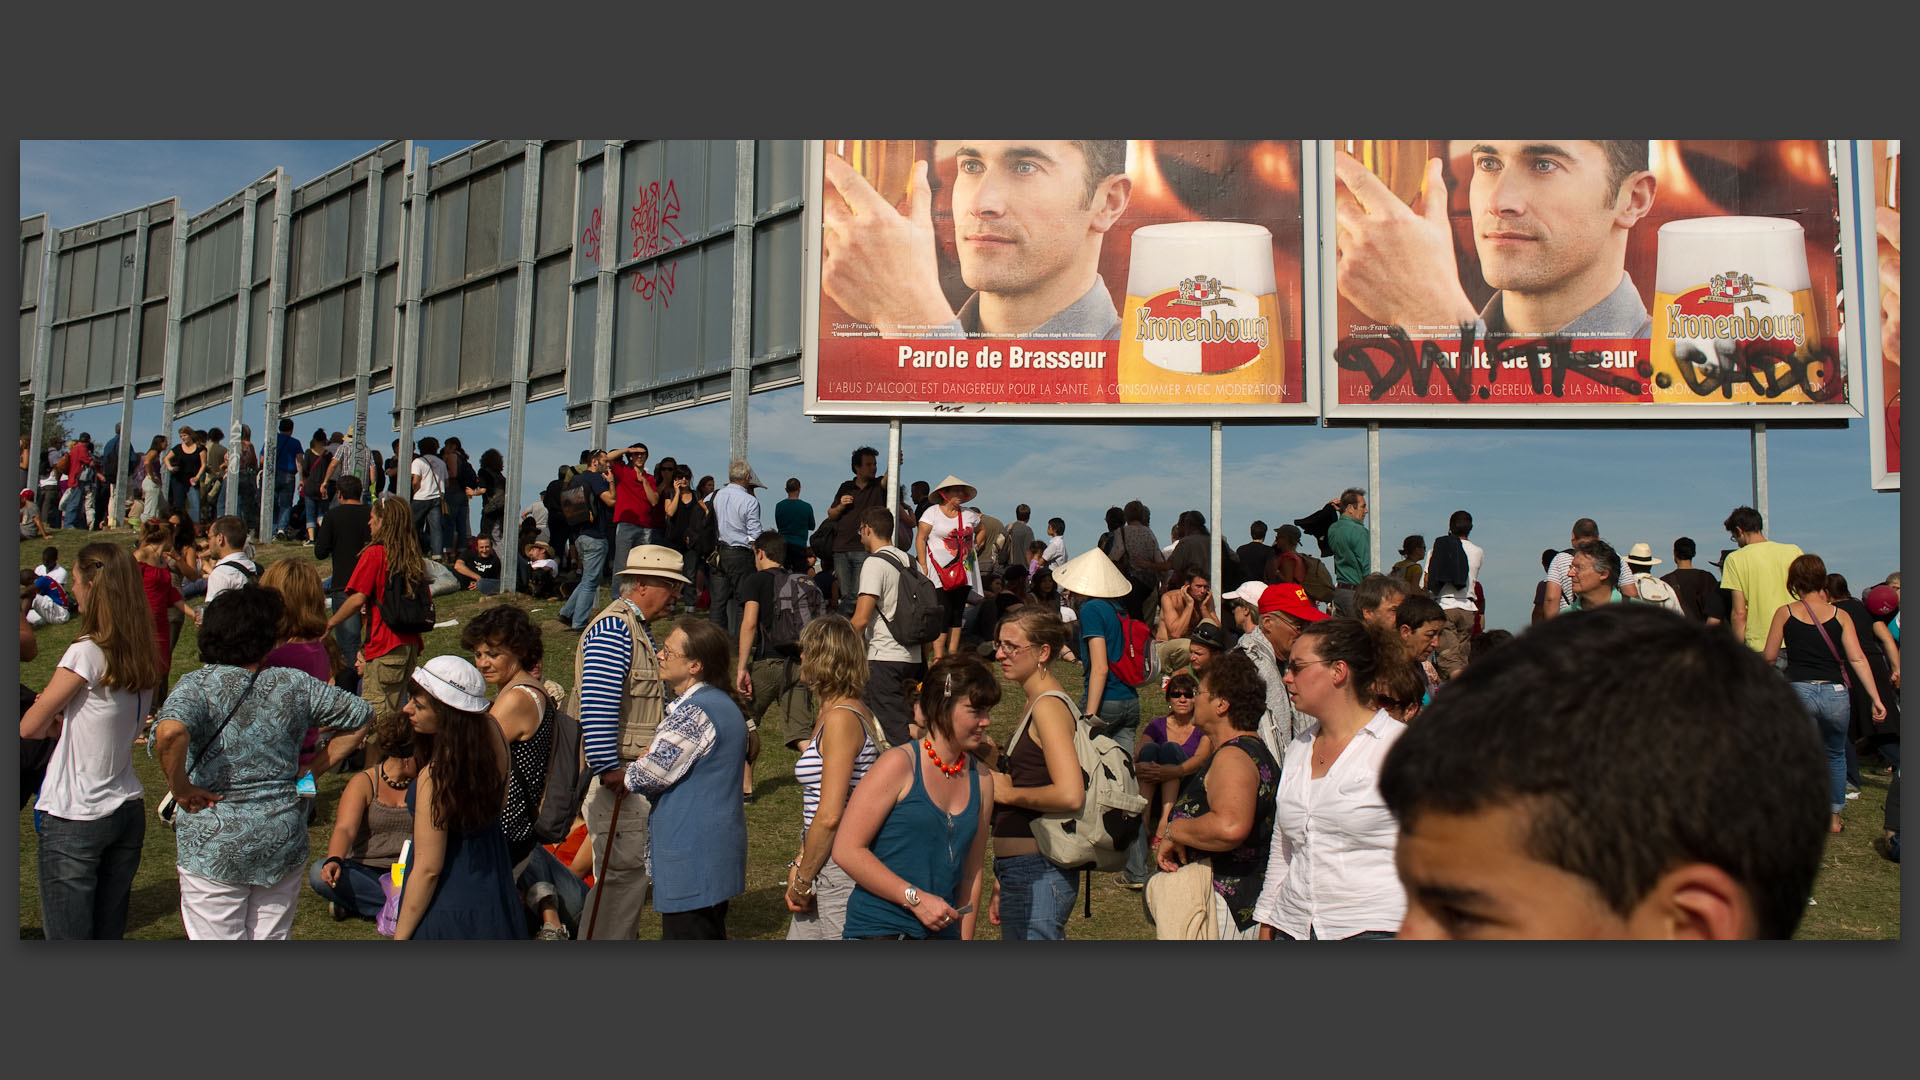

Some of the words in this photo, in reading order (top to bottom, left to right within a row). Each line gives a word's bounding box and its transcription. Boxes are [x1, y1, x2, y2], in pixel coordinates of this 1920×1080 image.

[1136, 307, 1269, 347] Kronenbourg
[1667, 305, 1804, 344] Kronenbourg
[898, 346, 969, 368] Parole
[975, 346, 1002, 368] de
[1009, 346, 1107, 369] Brasseur
[829, 382, 862, 394] L'ABUS
[866, 382, 917, 395] D'ALCOOL
[921, 382, 939, 395] EST
[942, 383, 1005, 395] DANGEREUX
[1008, 383, 1035, 395] POUR
[1040, 383, 1051, 395] LA
[1107, 383, 1181, 396] CONSOMMER
[1185, 383, 1211, 396] AVEC
[1215, 383, 1291, 396] MODERATION.
[1570, 384, 1582, 396] LA
